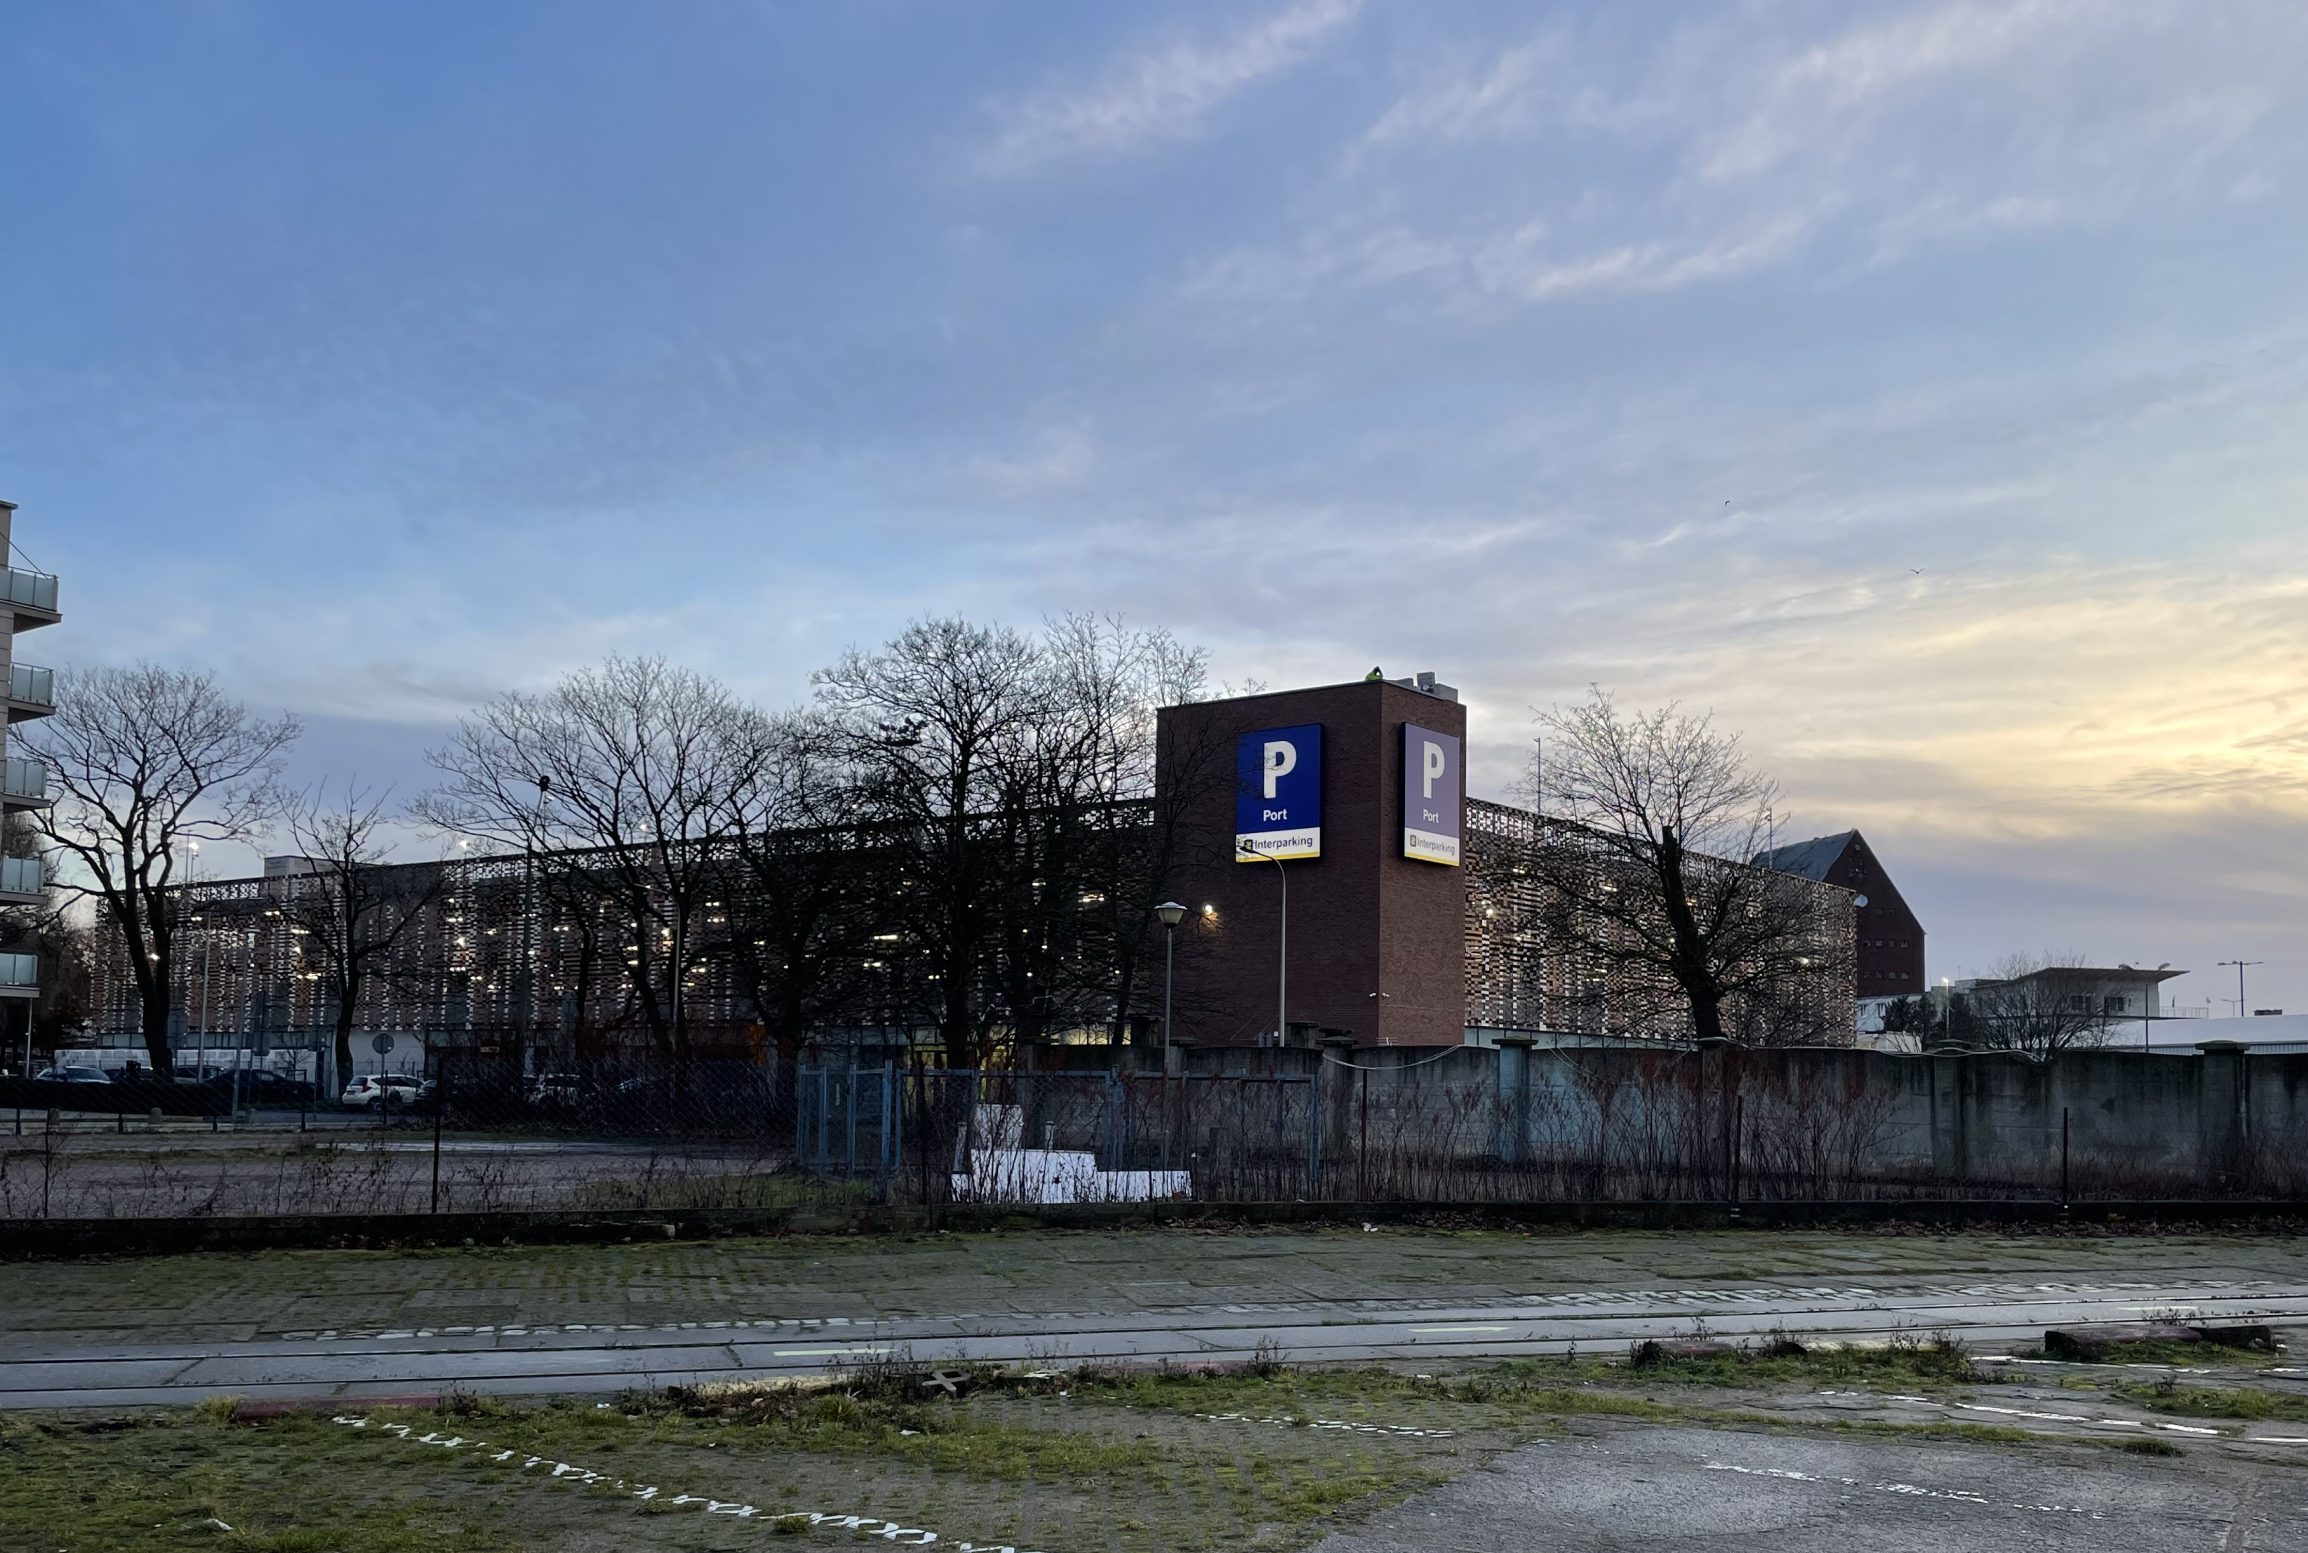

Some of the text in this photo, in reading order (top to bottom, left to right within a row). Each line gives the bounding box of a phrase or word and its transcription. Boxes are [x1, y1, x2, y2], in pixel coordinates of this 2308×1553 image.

[1263, 740, 1297, 799] P
[1423, 740, 1445, 799] P
[1263, 808, 1288, 822] Port
[1422, 809, 1439, 824] Port
[1254, 836, 1313, 851] Interparking
[1417, 837, 1455, 856] Interparking
